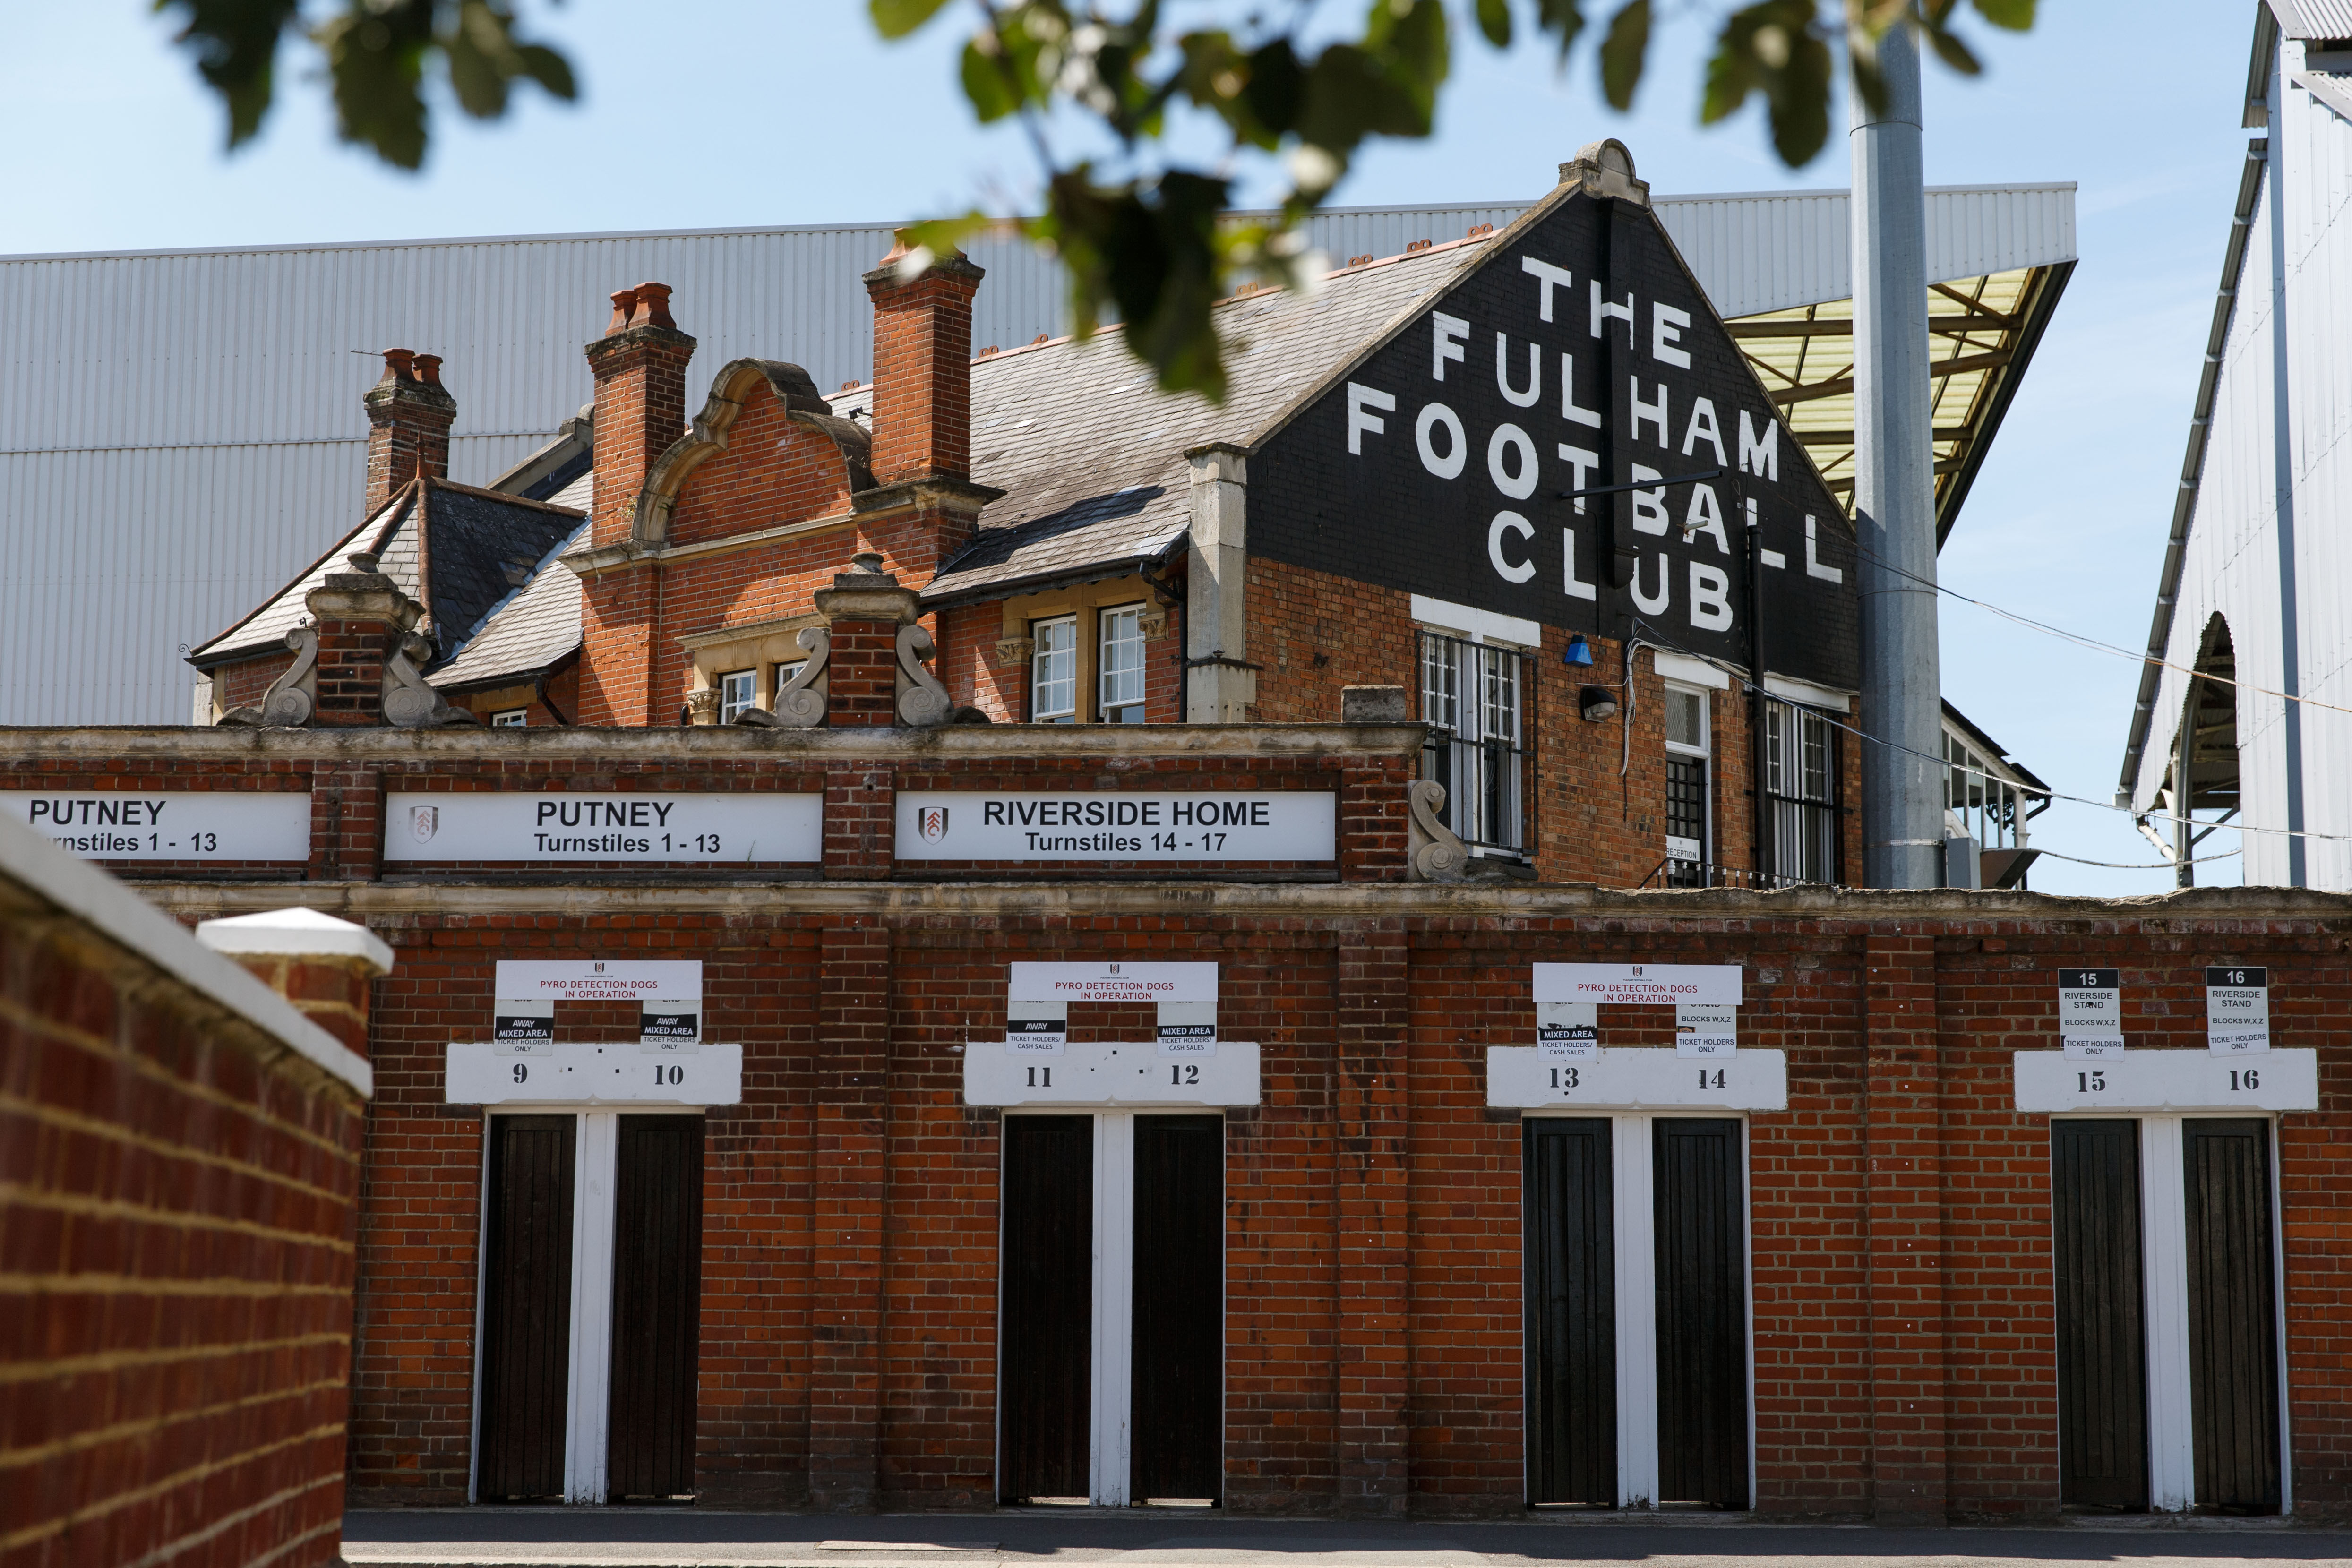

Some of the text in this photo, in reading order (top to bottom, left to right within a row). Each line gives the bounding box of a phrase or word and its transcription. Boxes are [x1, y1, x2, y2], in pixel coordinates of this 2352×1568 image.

[1522, 256, 1691, 369] THE
[1433, 310, 1778, 483] FULHAM
[1348, 381, 1843, 584] FOOTBALL
[1488, 509, 1733, 632] CLUB
[29, 799, 166, 826] PUTNEY
[536, 801, 674, 827] PUTNEY
[984, 800, 1270, 826] RIVERSIDE HOME
[46, 832, 139, 851] rnstiles
[148, 832, 158, 851] 1
[191, 833, 217, 851] 13
[534, 833, 650, 852] Turnstiles
[661, 834, 671, 852] 1
[695, 834, 720, 853] 13
[1025, 832, 1142, 852] Turnstiles
[1151, 833, 1176, 852] 14
[1201, 833, 1227, 852] 17
[1666, 848, 1697, 859] RECEPTION
[540, 980, 567, 988] PYRO
[1055, 982, 1174, 990] PYRO DETECTION DOGS
[2079, 973, 2097, 985] 15
[2227, 971, 2245, 984] 16
[1081, 992, 1152, 1000] IN OPERATION
[1578, 984, 1698, 993] PYRO DETECTION DOGS
[1604, 994, 1676, 1002] IN OPERATION
[512, 1020, 535, 1028] AWAY
[2235, 1034, 2266, 1042] HOLDERS
[513, 1063, 528, 1084] 9
[654, 1065, 684, 1086] 10
[1026, 1067, 1052, 1088] 11
[1171, 1064, 1200, 1085] 12
[1550, 1068, 1579, 1088] 13
[1699, 1069, 1726, 1089] 14
[2077, 1071, 2105, 1092] 15
[2230, 1069, 2259, 1091] 16
